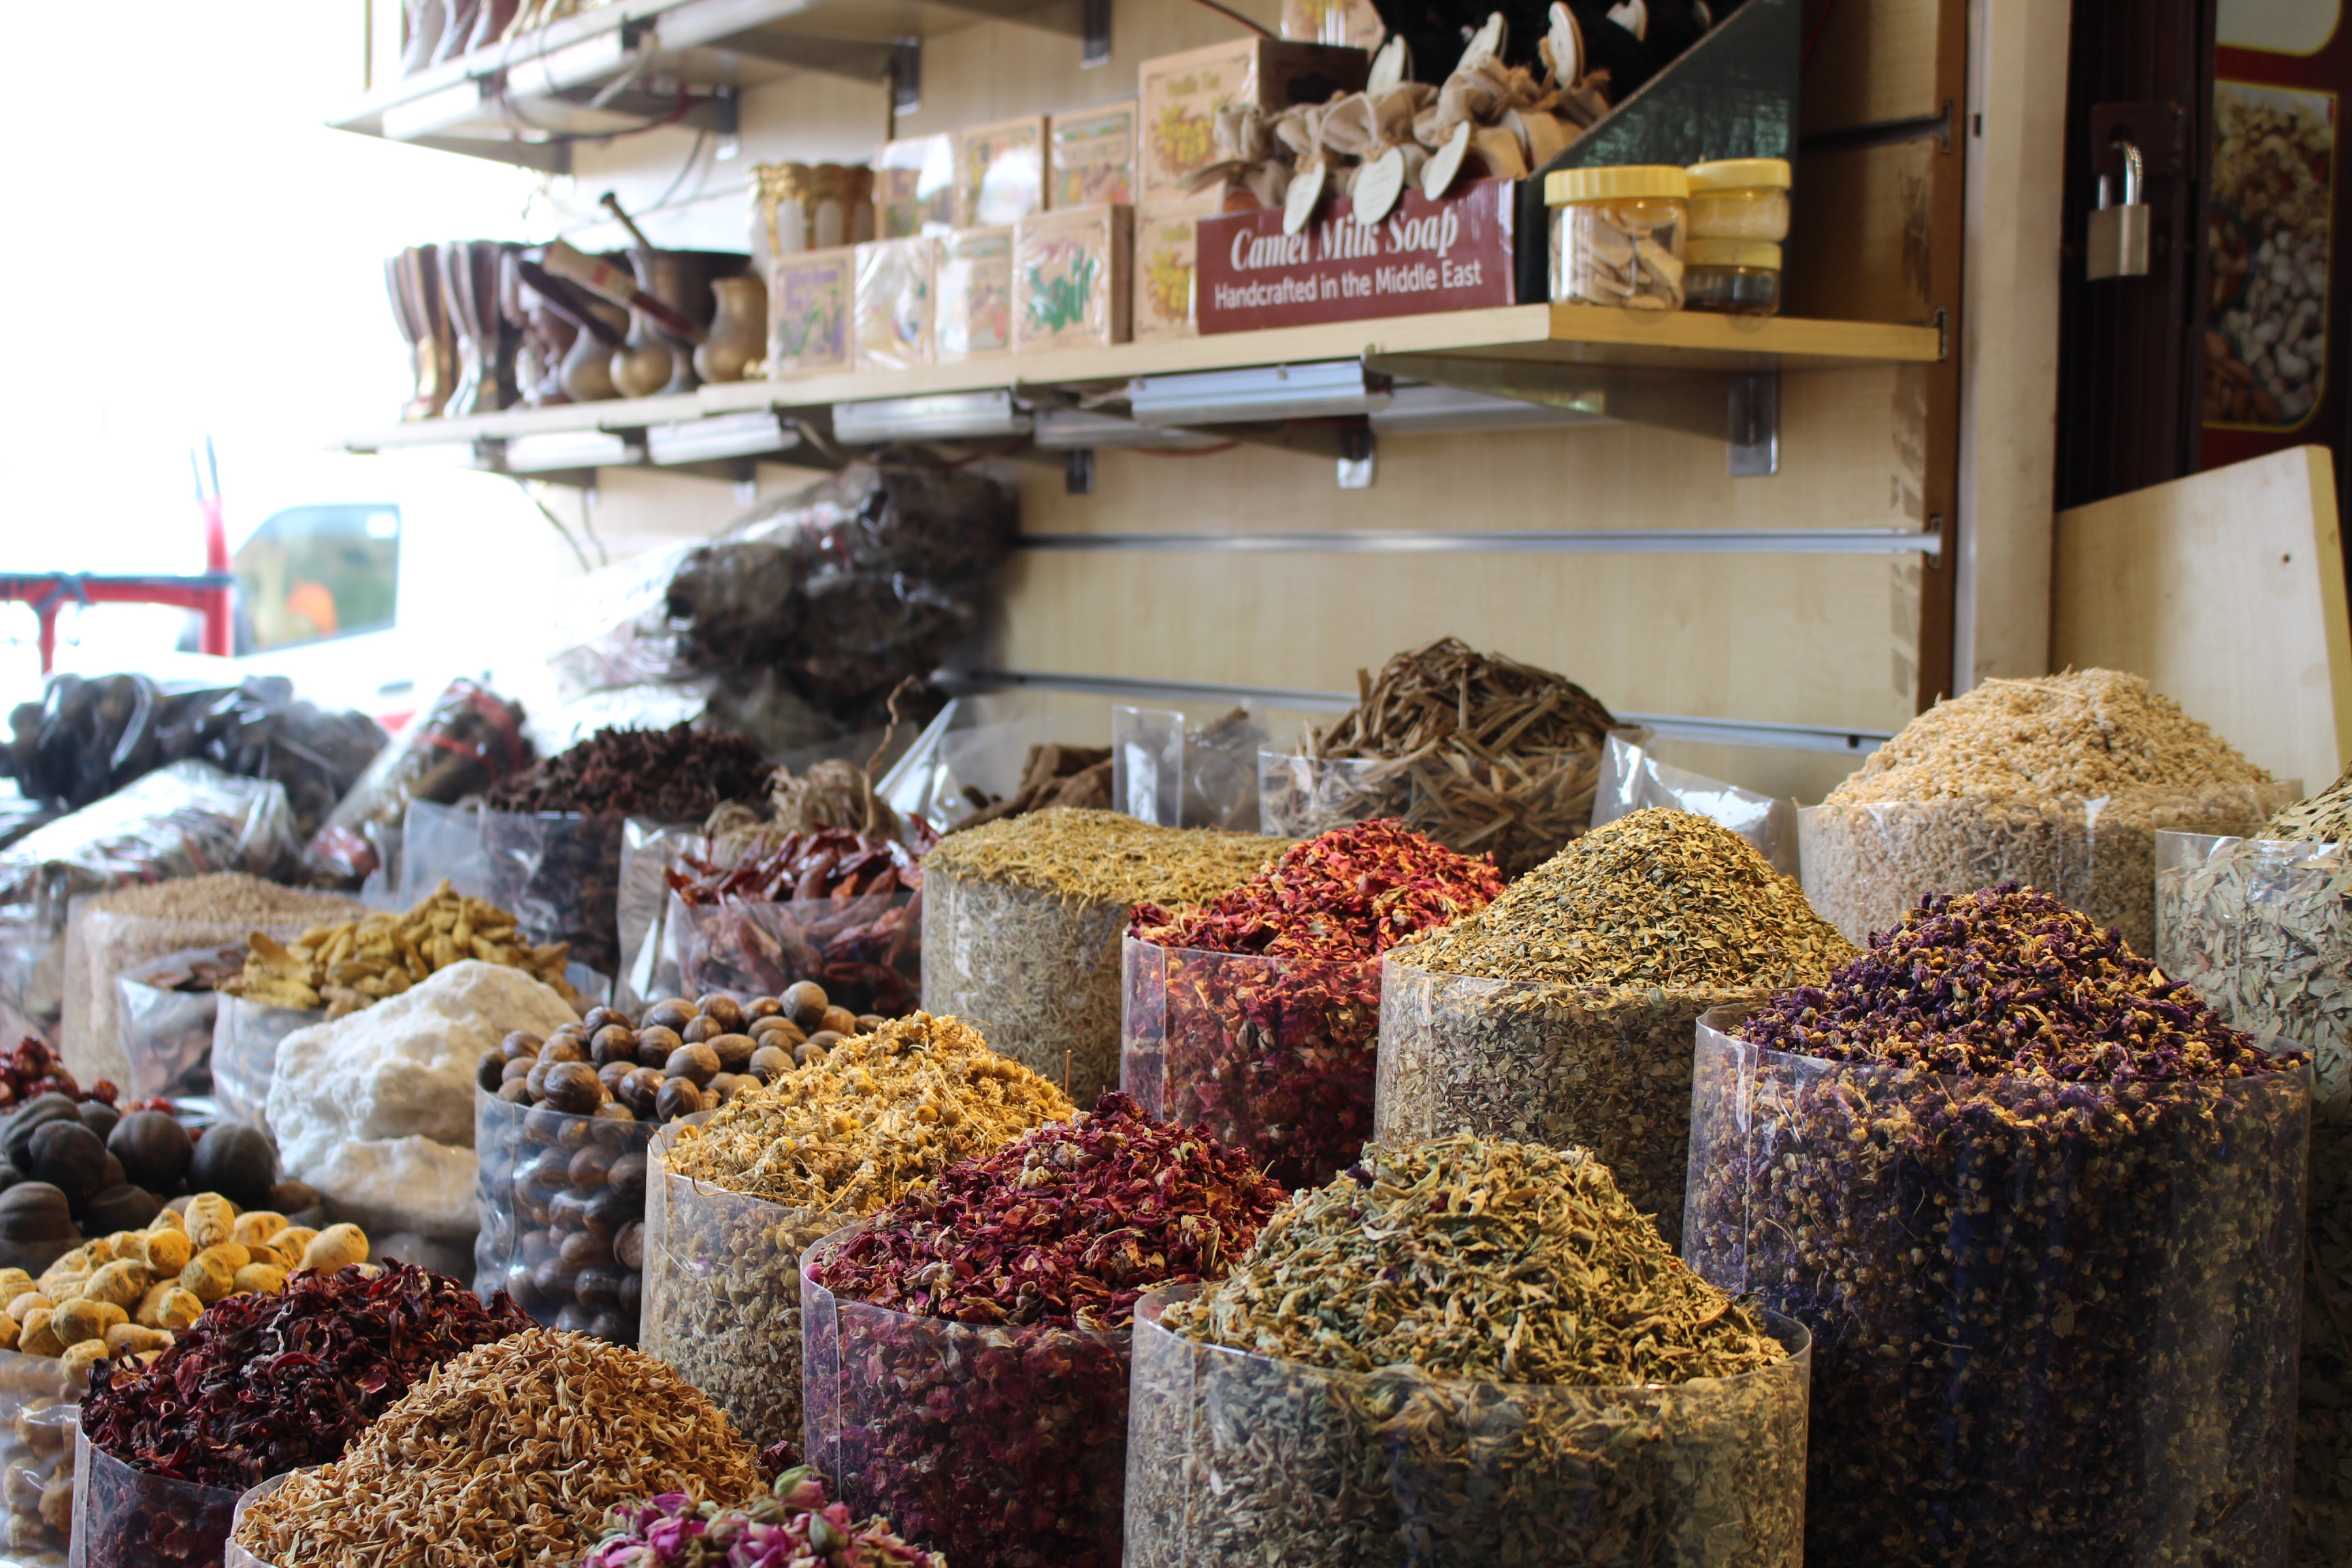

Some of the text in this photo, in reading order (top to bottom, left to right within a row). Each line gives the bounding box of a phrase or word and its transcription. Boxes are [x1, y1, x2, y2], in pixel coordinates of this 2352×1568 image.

[1230, 206, 1459, 272] Camel Milk Soap
[1214, 259, 1483, 310] Handcrafted in the Middle East
